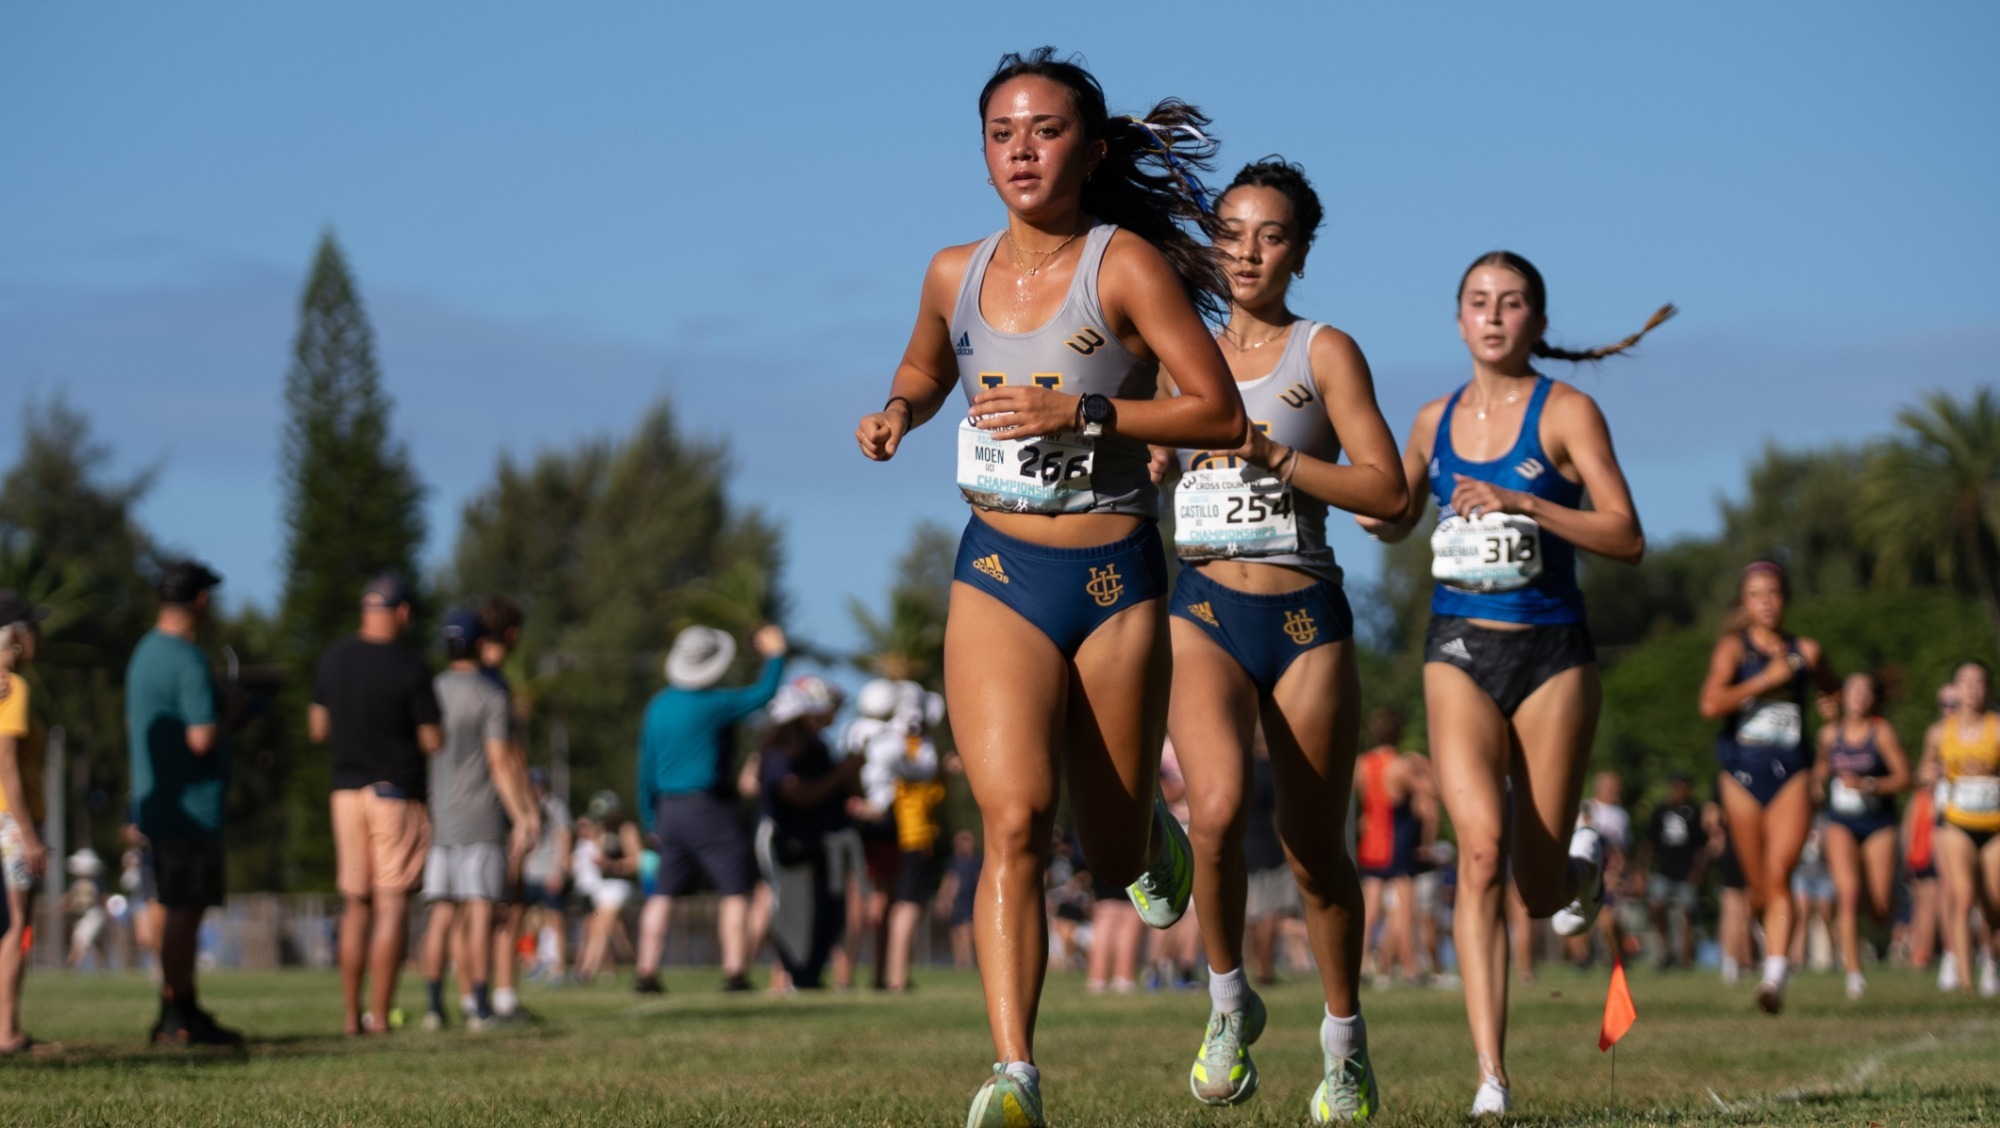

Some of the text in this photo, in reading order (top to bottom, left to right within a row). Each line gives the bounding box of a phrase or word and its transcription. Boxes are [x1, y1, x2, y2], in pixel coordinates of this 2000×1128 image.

[974, 445, 1005, 464] MOEN
[1018, 445, 1090, 483] 266
[1181, 504, 1220, 519] CASTILLO
[1226, 491, 1293, 524] 254
[1189, 526, 1277, 541] CHAMPIONSHIPS
[1484, 535, 1537, 564] 313
[972, 559, 1010, 585] adidas
